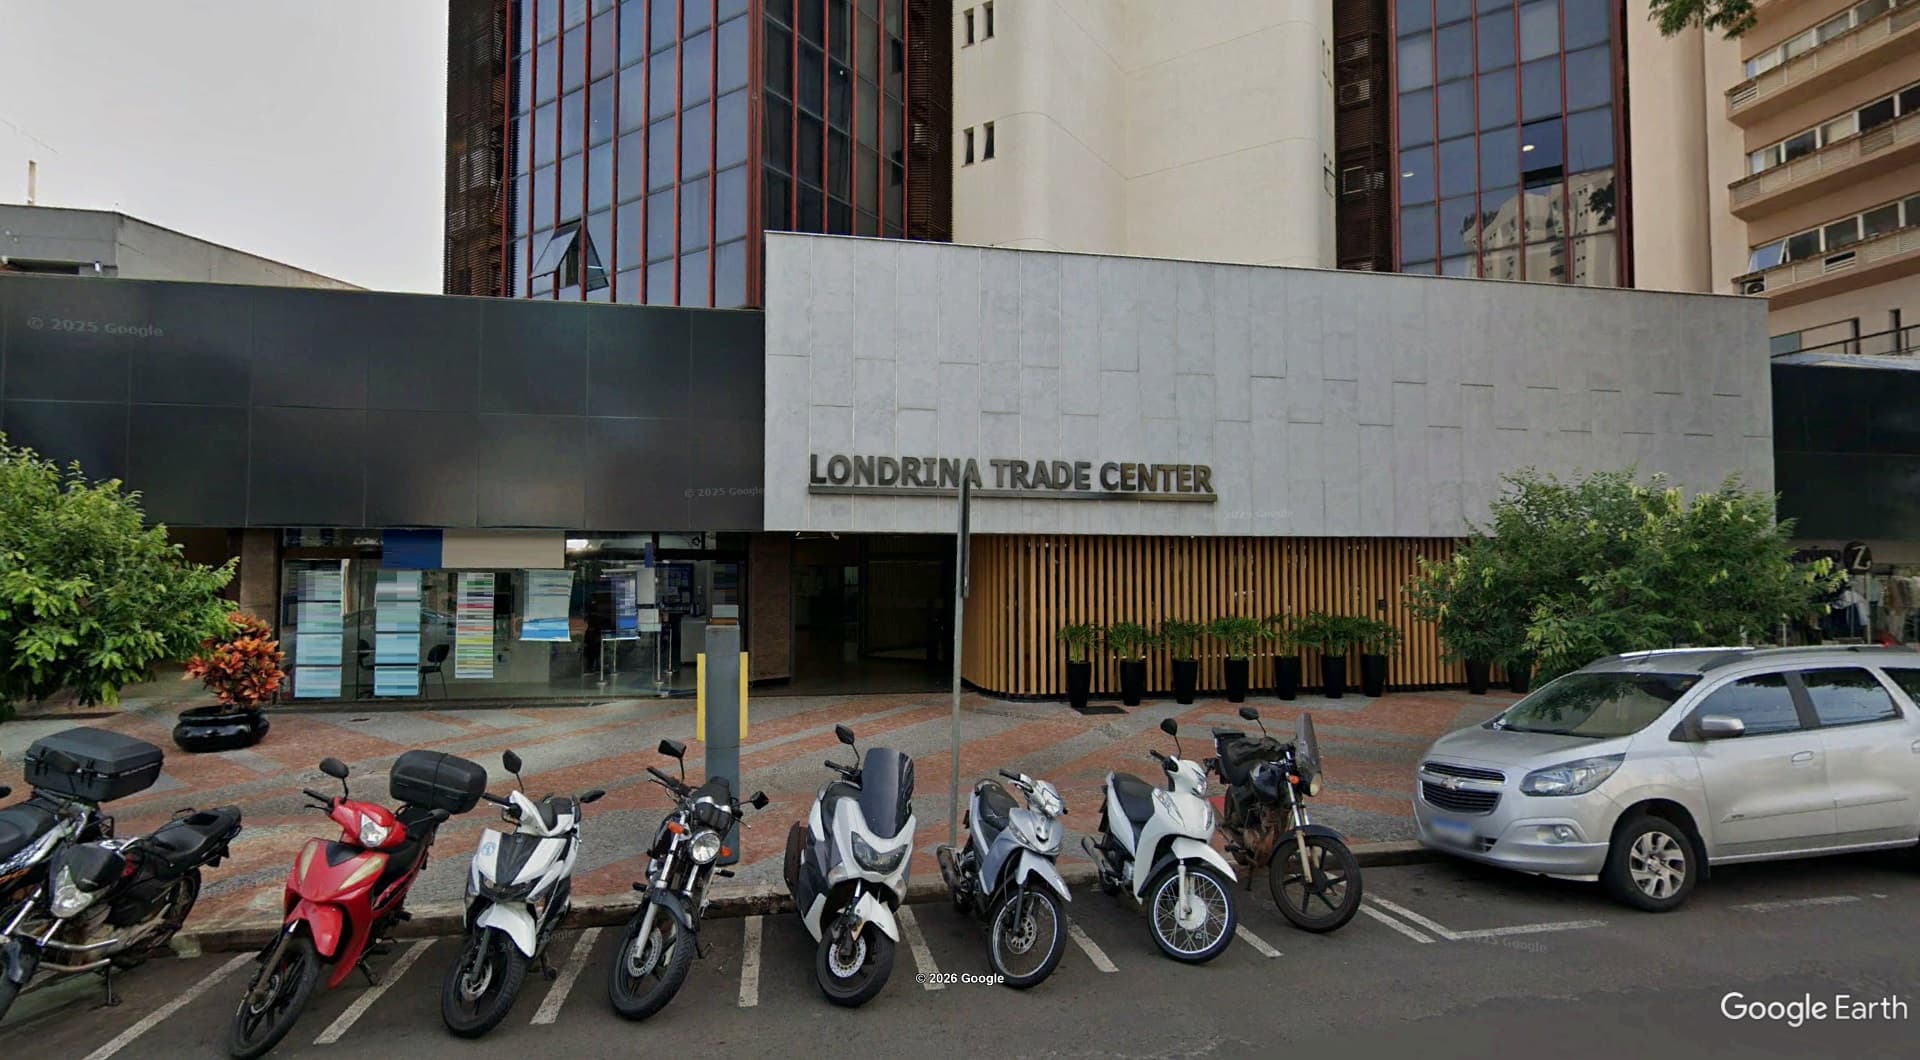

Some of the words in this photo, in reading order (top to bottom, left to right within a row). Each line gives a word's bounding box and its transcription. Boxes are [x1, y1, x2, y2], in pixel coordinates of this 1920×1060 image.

[810, 454, 982, 488] LONDRINA
[990, 458, 1091, 491] TRADE
[1100, 461, 1213, 493] CENTER
